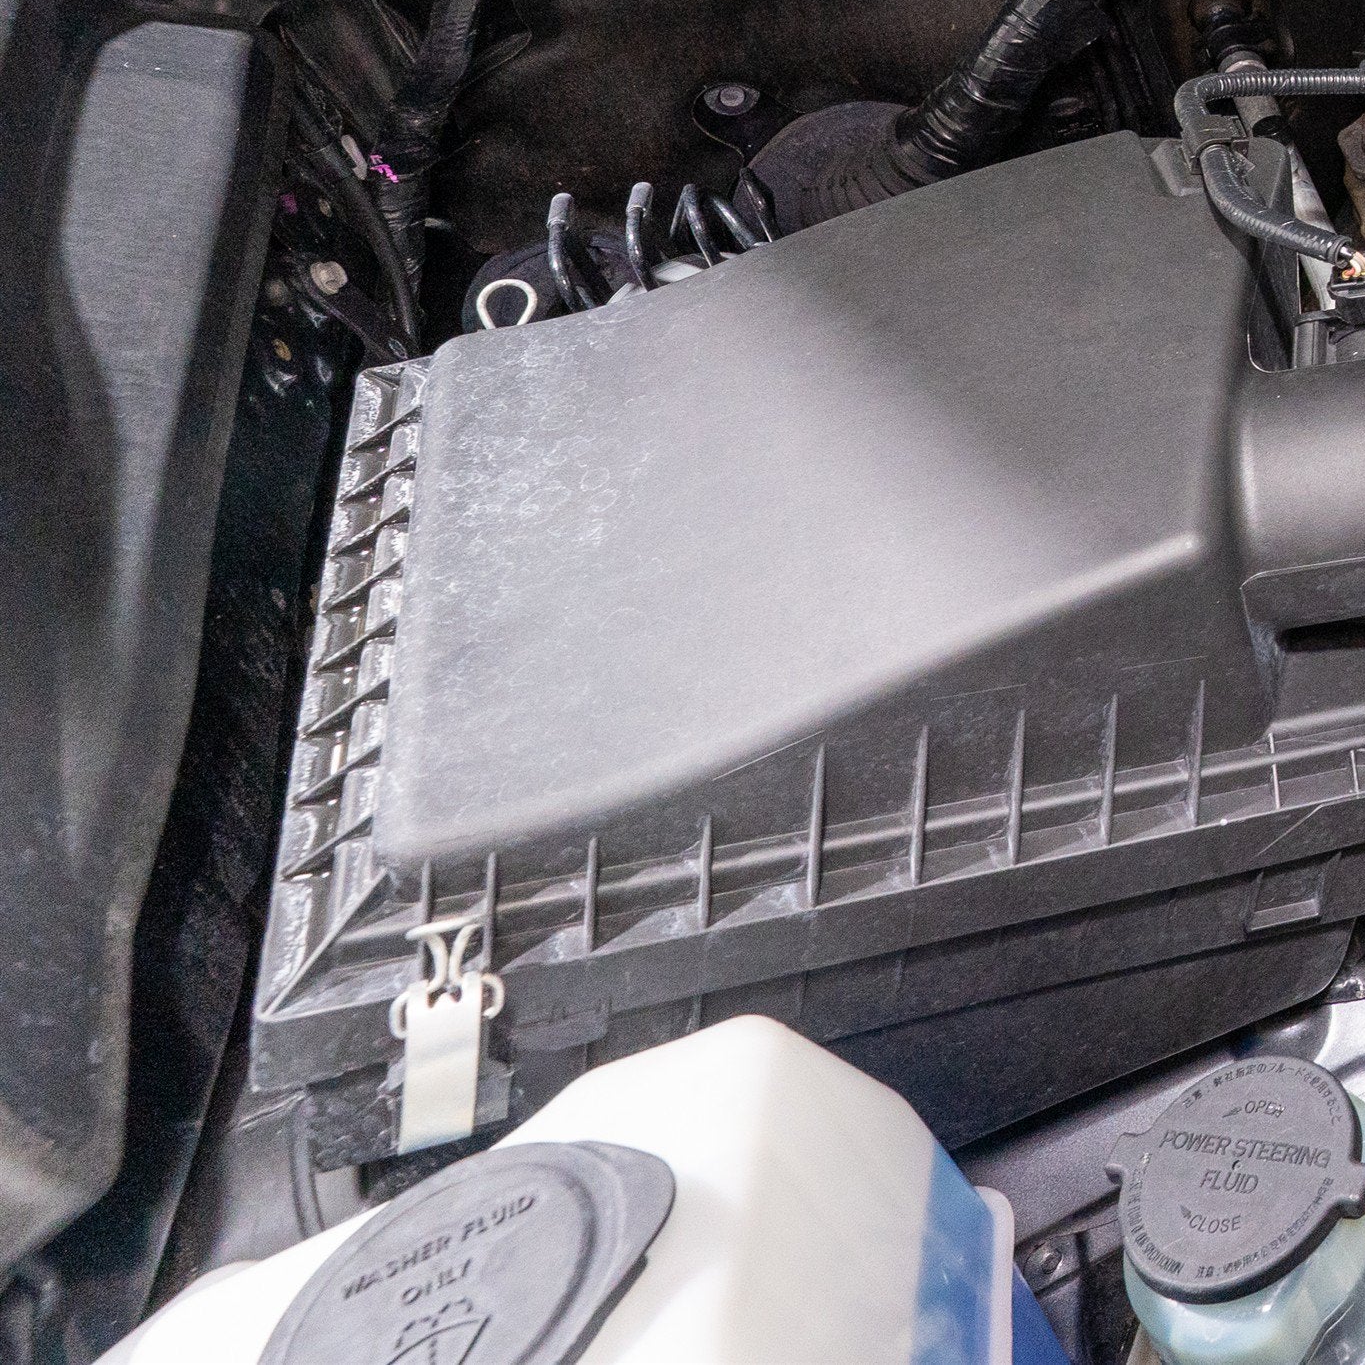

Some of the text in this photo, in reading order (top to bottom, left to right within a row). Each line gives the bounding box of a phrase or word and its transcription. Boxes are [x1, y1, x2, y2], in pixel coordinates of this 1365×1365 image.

[1244, 1099, 1286, 1118] OPEN
[1159, 1130, 1332, 1169] POWER STEERING
[1200, 1168, 1259, 1195] FLUID
[1189, 1214, 1243, 1234] CLOSE
[341, 1194, 536, 1299] WASHER FLUID
[400, 1257, 473, 1306] ONLY
